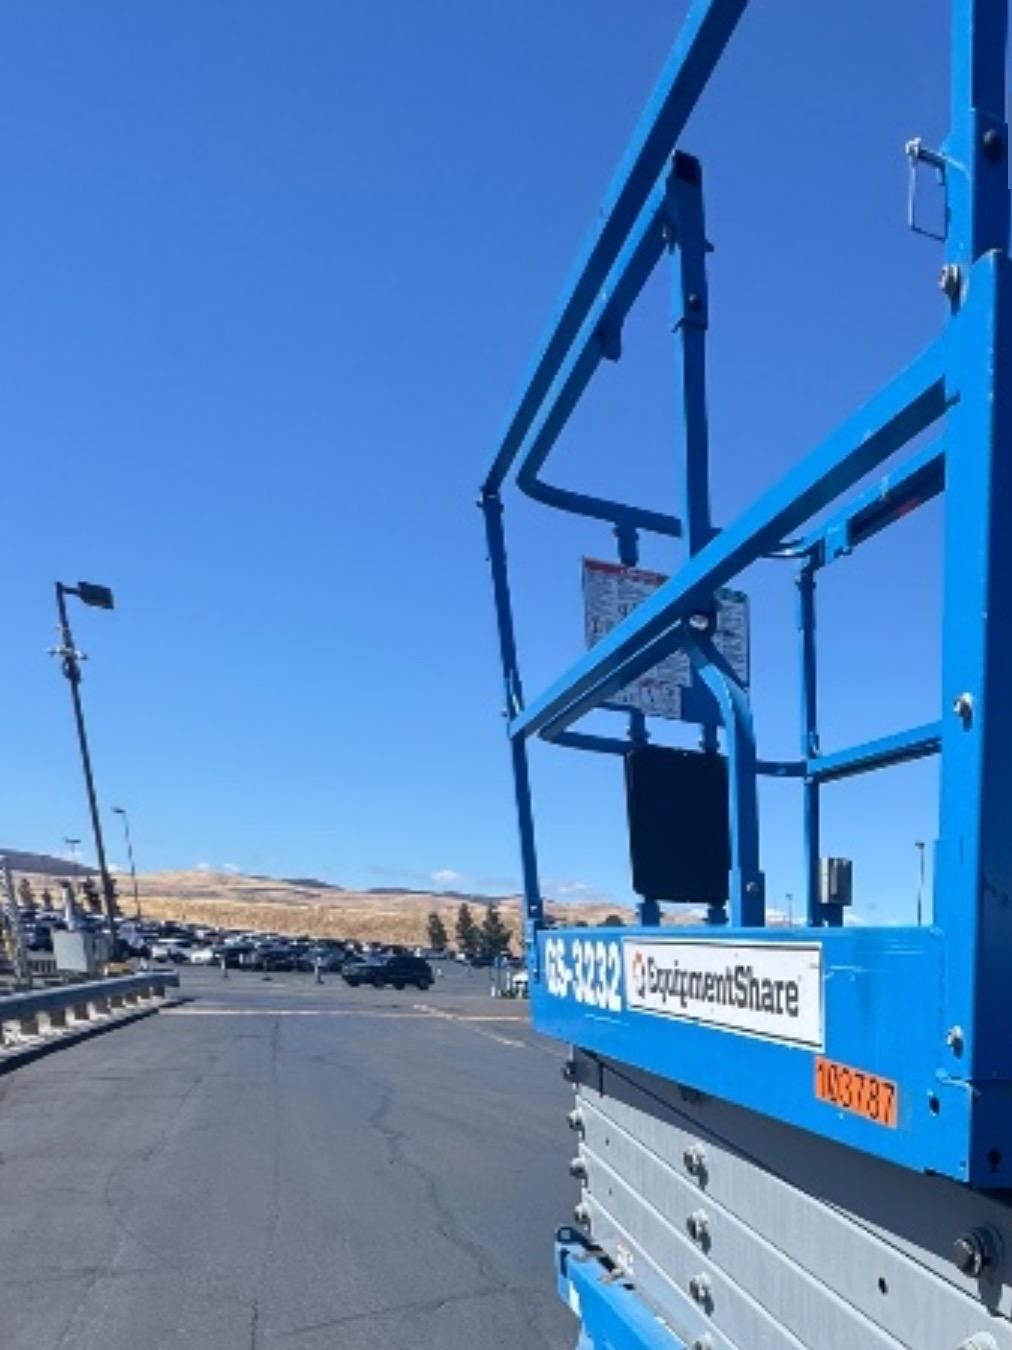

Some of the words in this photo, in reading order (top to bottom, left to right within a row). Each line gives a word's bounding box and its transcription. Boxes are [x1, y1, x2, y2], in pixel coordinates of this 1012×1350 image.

[545, 937, 622, 1012] GS-3232
[647, 956, 799, 1017] EquipmentShare
[817, 1063, 895, 1124] 103787
